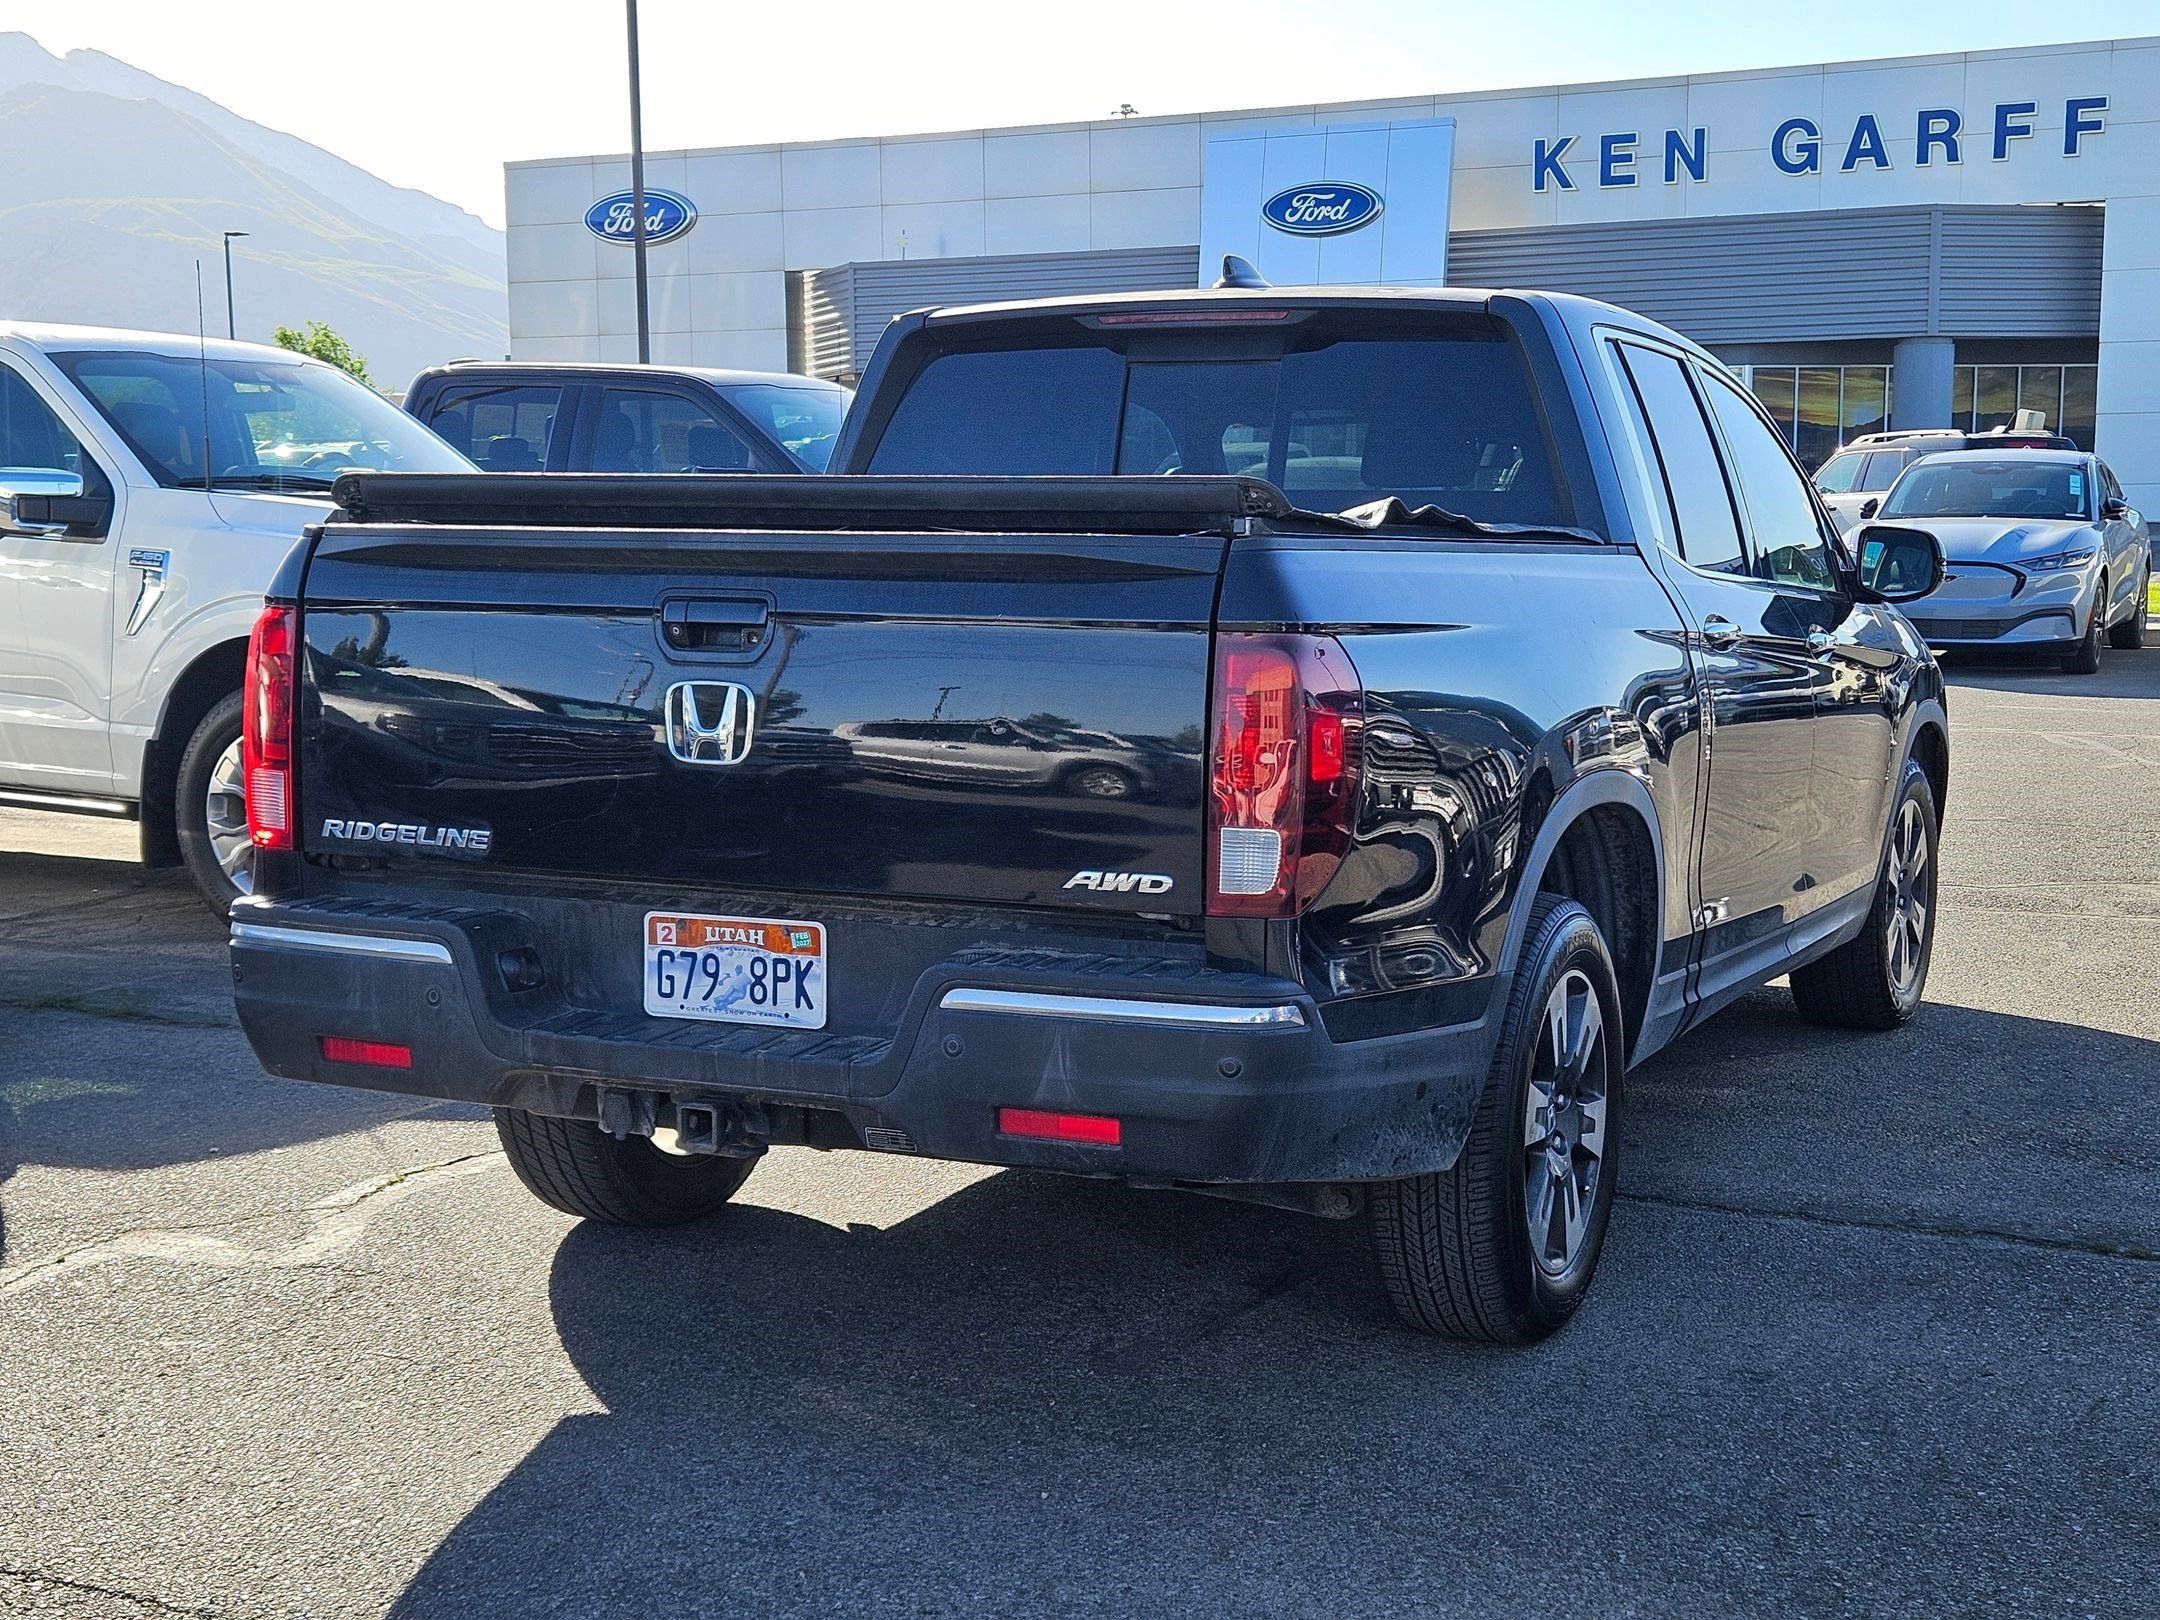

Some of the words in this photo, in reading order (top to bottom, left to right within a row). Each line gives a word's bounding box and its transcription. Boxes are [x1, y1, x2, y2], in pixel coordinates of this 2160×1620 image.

[1532, 126, 1708, 193] KEN
[1769, 95, 2111, 176] GARFF
[603, 202, 665, 234] Fod
[1284, 193, 1352, 223] Ford
[321, 819, 492, 850] RIDGELINE
[1062, 870, 1174, 894] AWD
[661, 925, 673, 943] 2
[704, 926, 765, 946] UTAH
[795, 932, 809, 940] FEB
[657, 949, 721, 1001] G79
[749, 956, 814, 1010] 8PK
